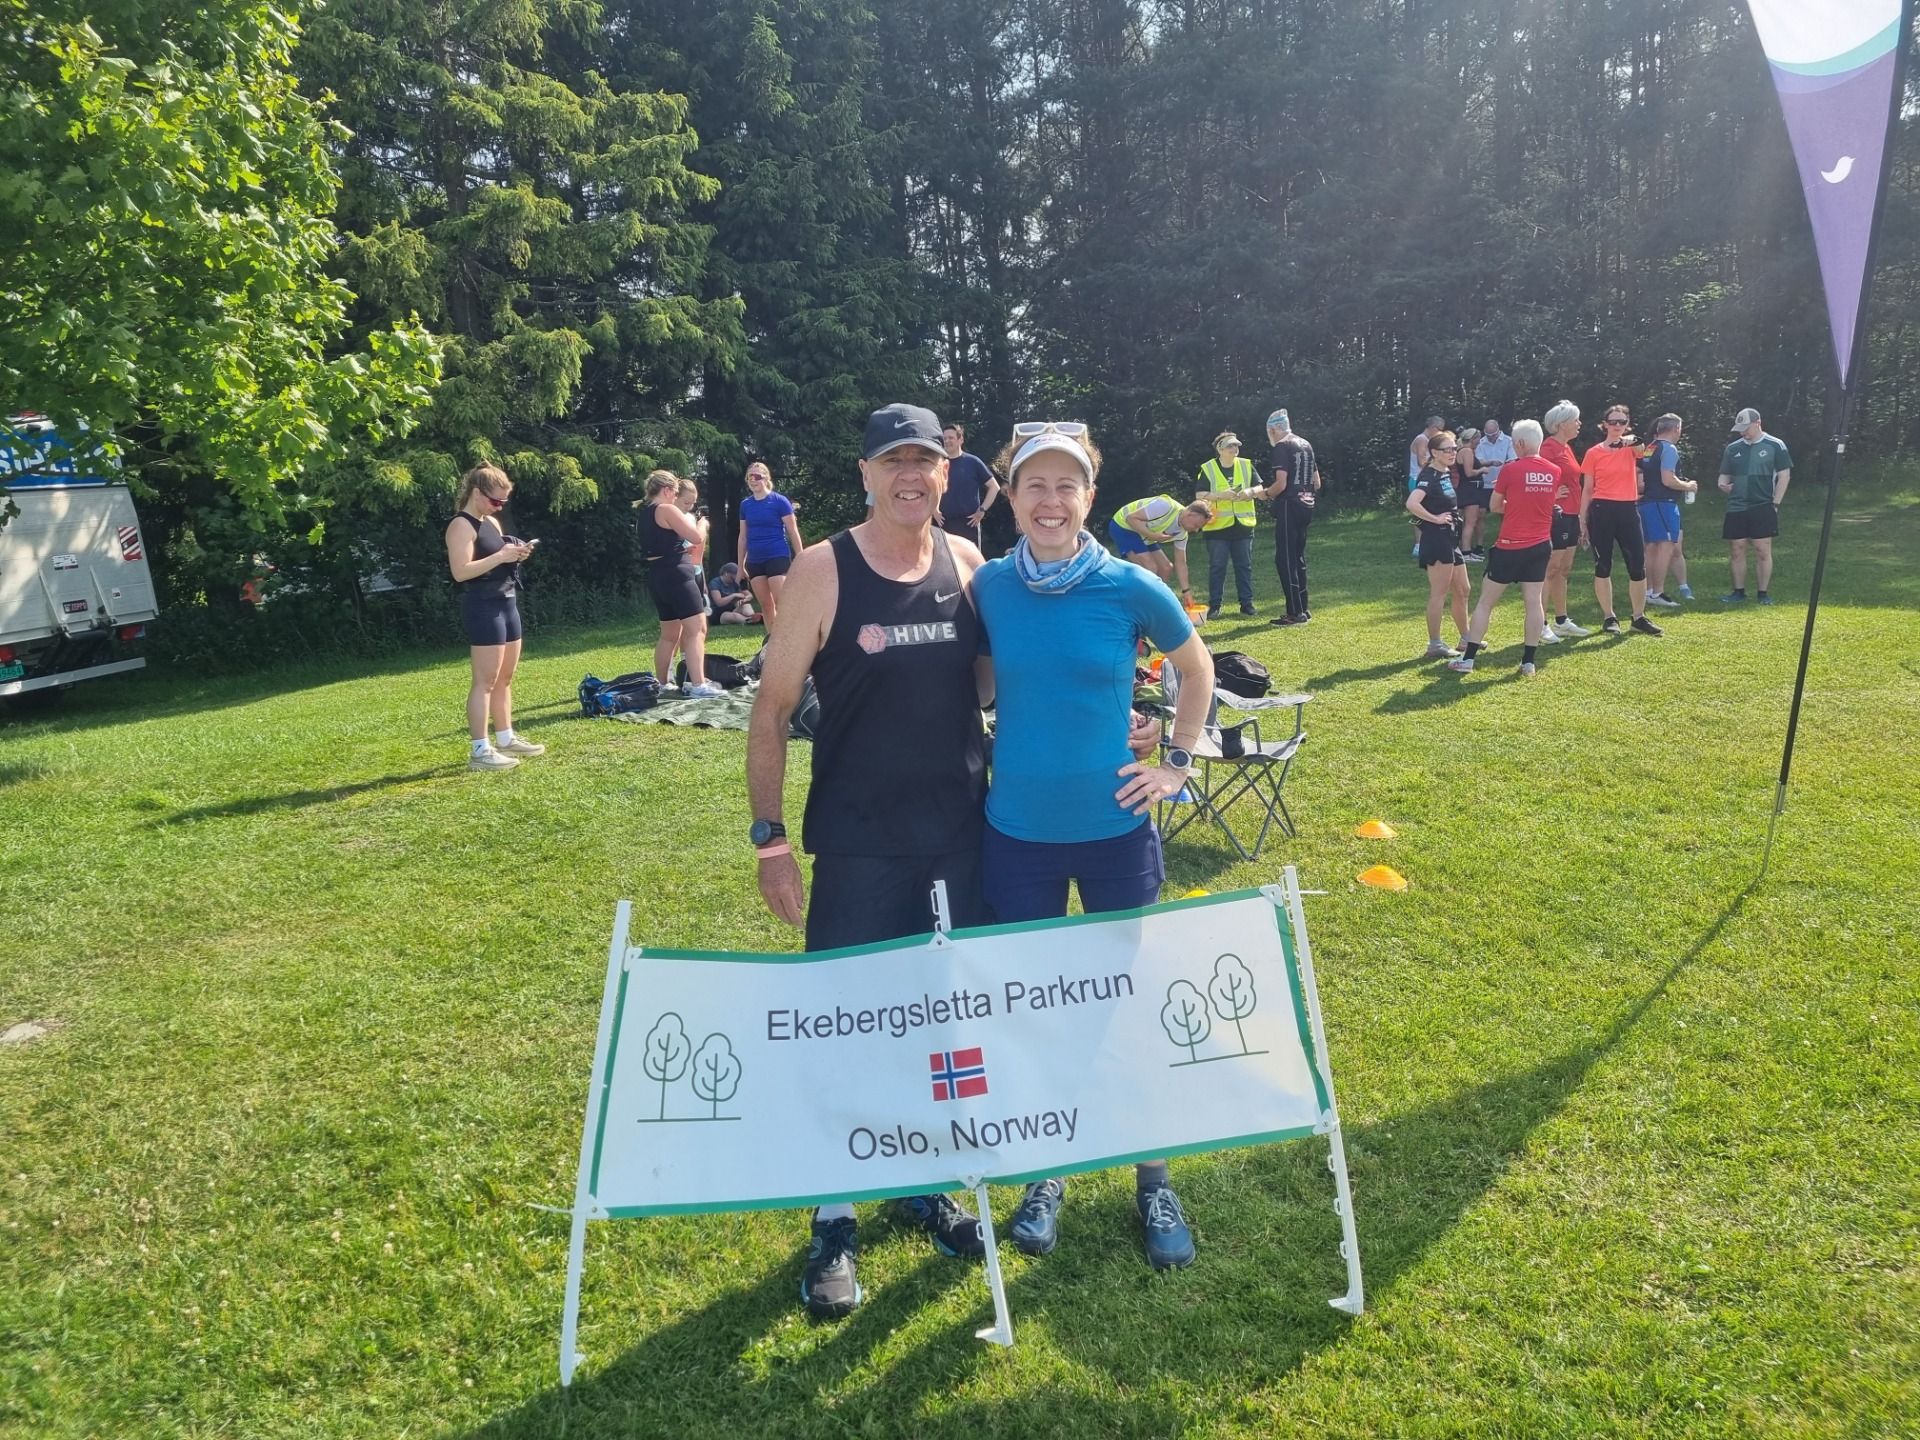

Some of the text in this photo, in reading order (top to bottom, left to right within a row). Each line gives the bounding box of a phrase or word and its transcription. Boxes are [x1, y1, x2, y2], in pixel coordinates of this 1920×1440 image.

[1530, 472, 1553, 482] BDO
[894, 623, 955, 643] HIVE
[768, 973, 1134, 1040] Ekebergsletta Parkrun
[849, 1107, 1079, 1161] Oslo, Norway
